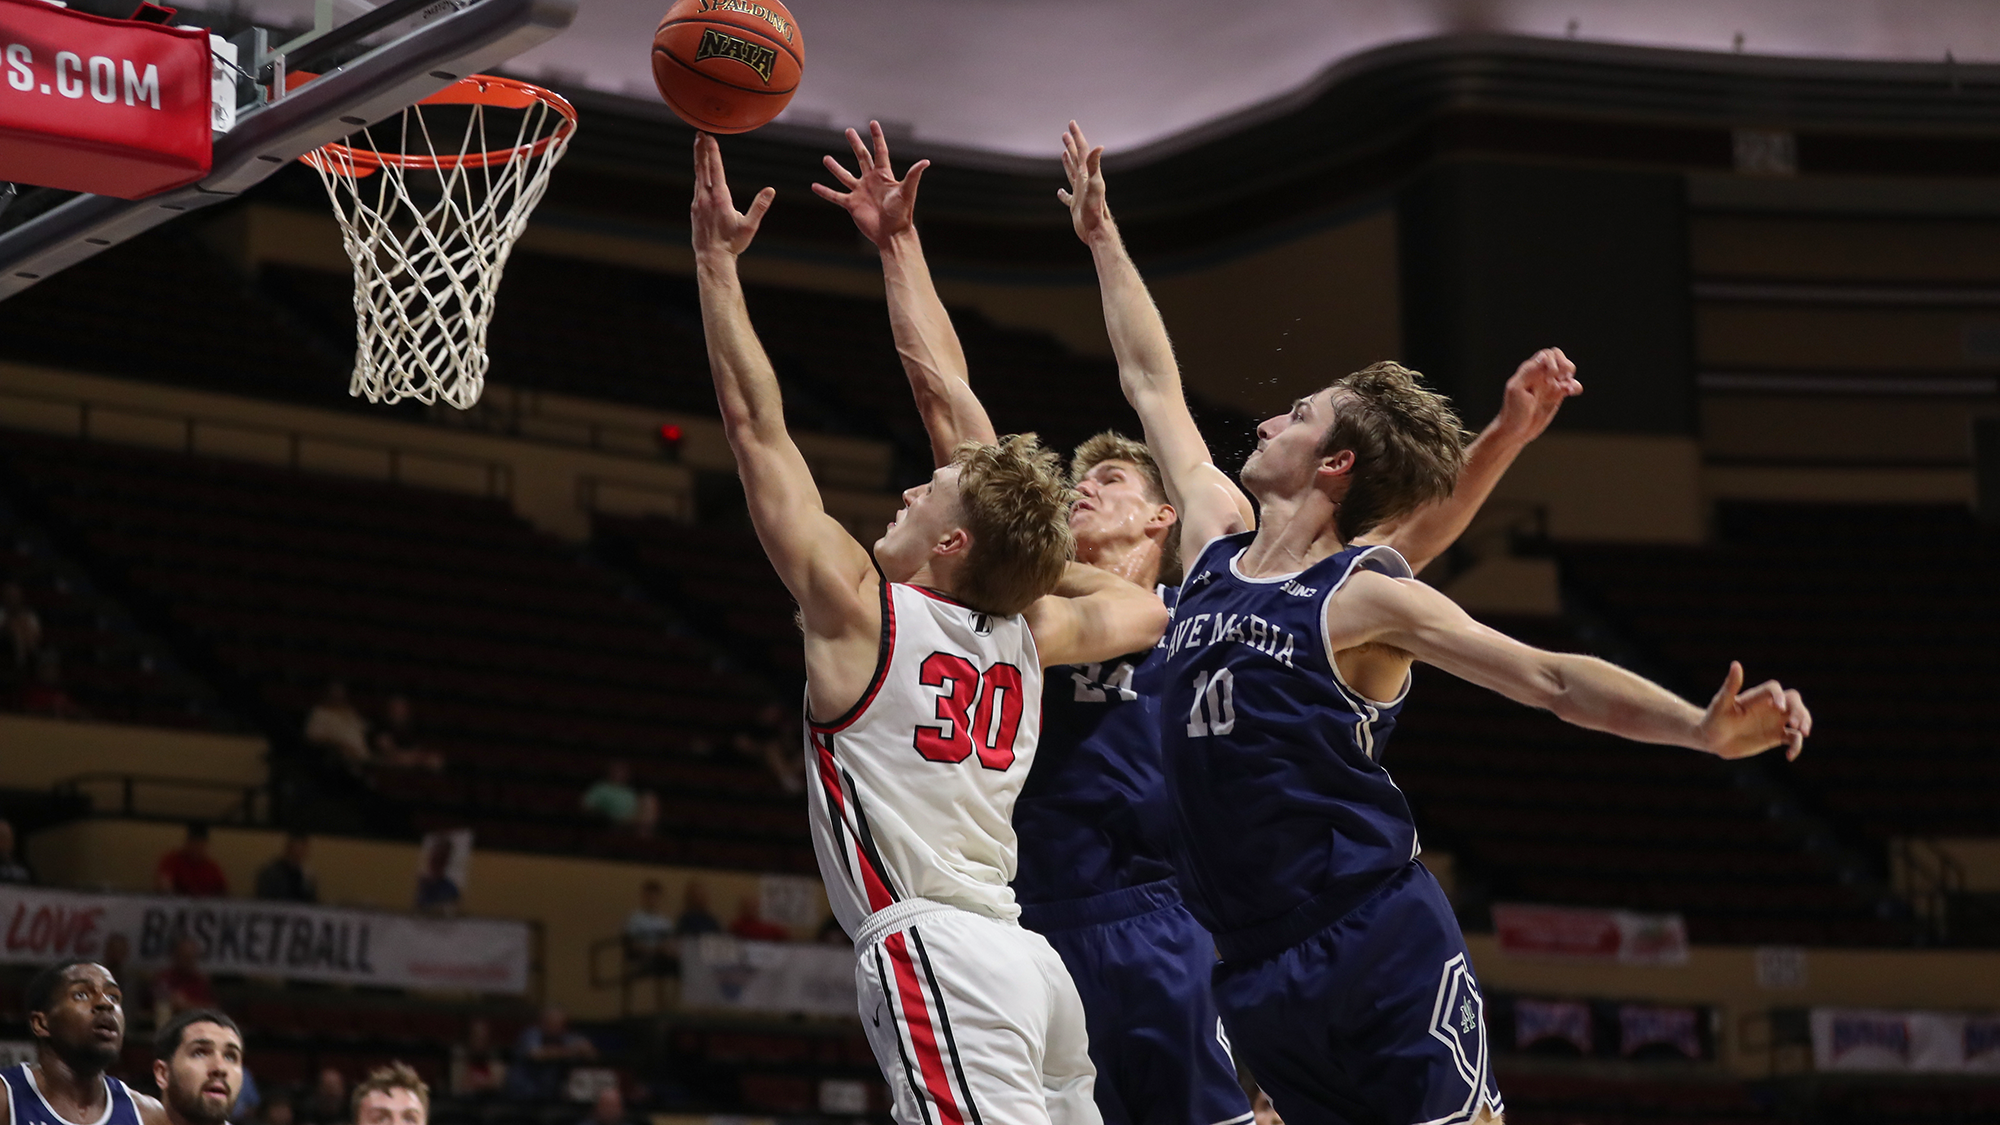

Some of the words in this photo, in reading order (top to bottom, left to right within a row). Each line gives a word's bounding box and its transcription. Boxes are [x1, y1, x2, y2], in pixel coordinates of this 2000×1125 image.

[0, 43, 161, 110] S.COM
[696, 29, 775, 83] NAIA
[1167, 613, 1211, 663] AVE
[1208, 612, 1294, 669] MARIA
[913, 651, 1023, 772] 30
[1187, 667, 1235, 738] 10
[6, 902, 105, 956] LOVE
